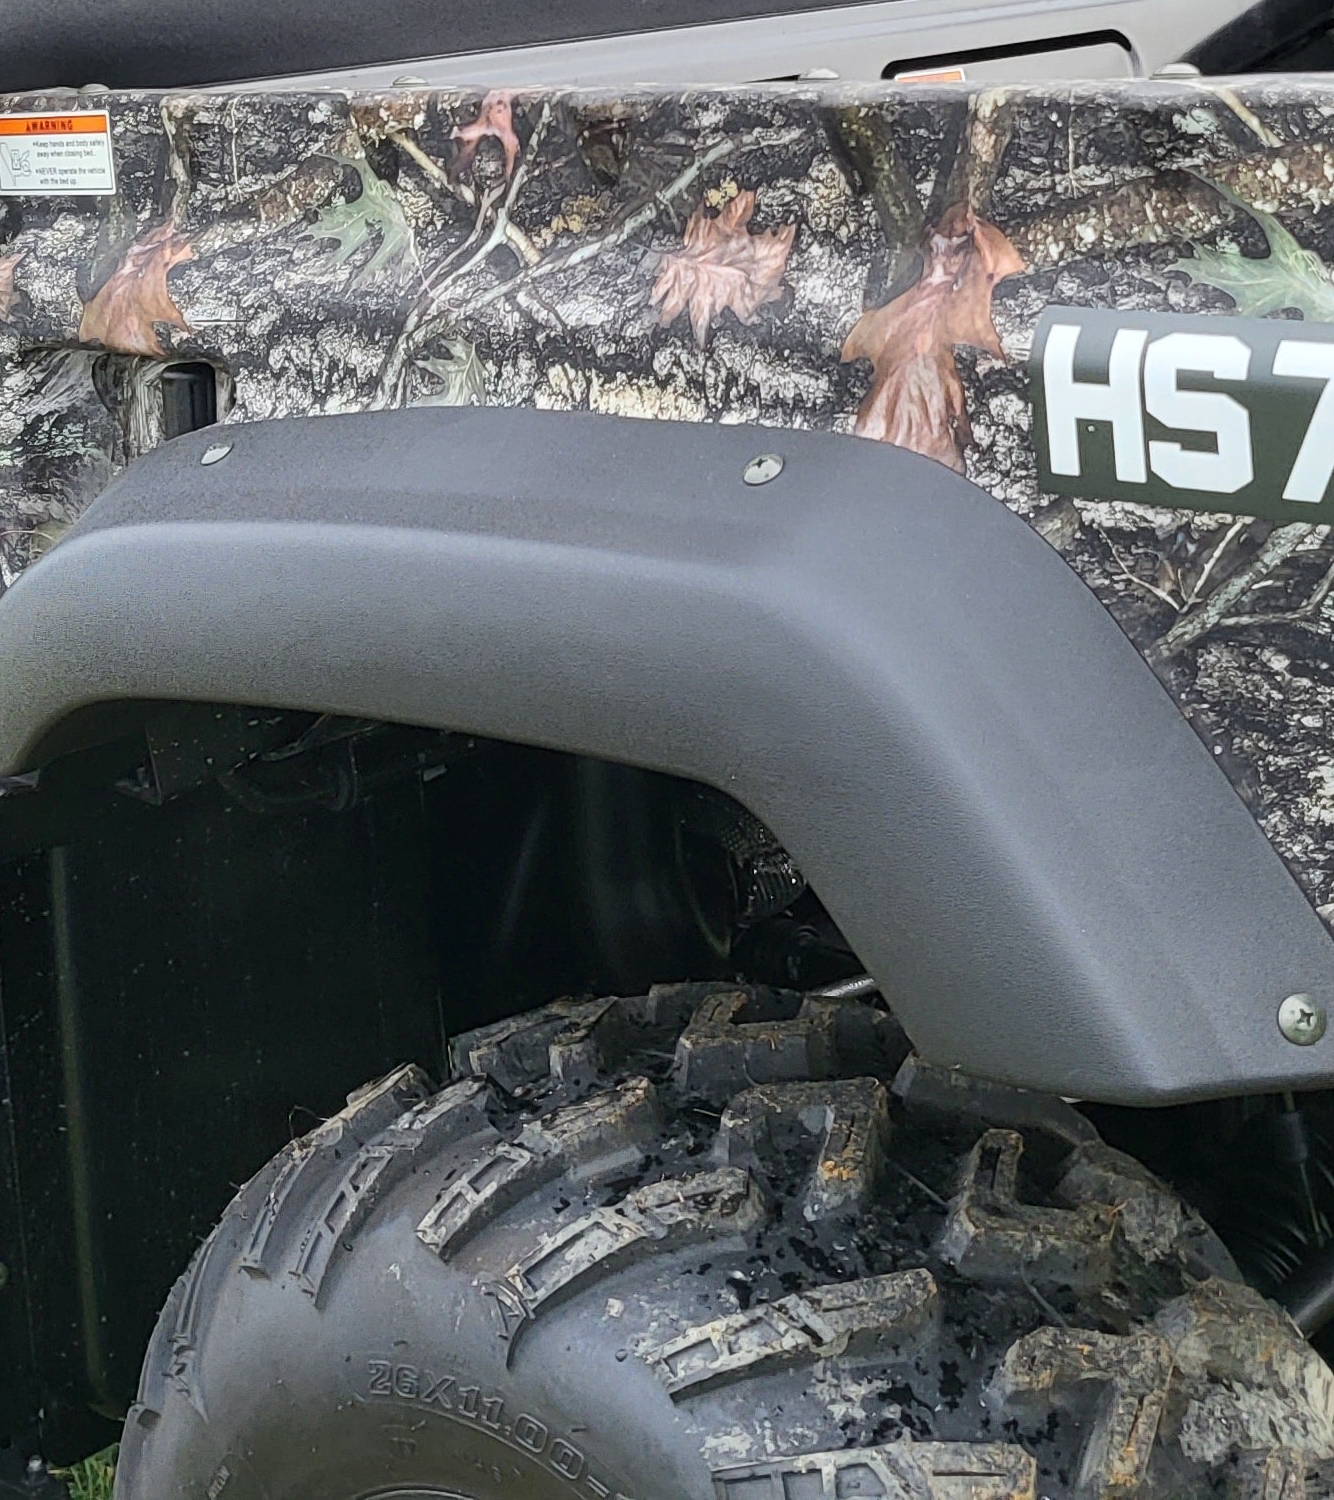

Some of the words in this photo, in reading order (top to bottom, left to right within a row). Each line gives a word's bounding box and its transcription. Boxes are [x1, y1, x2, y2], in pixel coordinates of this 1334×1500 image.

[32, 120, 74, 132] WARNING
[35, 140, 49, 148] Keep
[49, 140, 65, 148] hands
[65, 139, 75, 148] and
[76, 139, 89, 148] body
[36, 151, 50, 159] away
[50, 150, 64, 158] when
[38, 167, 58, 176] NEVER
[58, 167, 78, 176] operate
[78, 167, 87, 175] the
[87, 167, 106, 175] vehicle
[50, 177, 59, 185] the
[59, 177, 69, 185] bed
